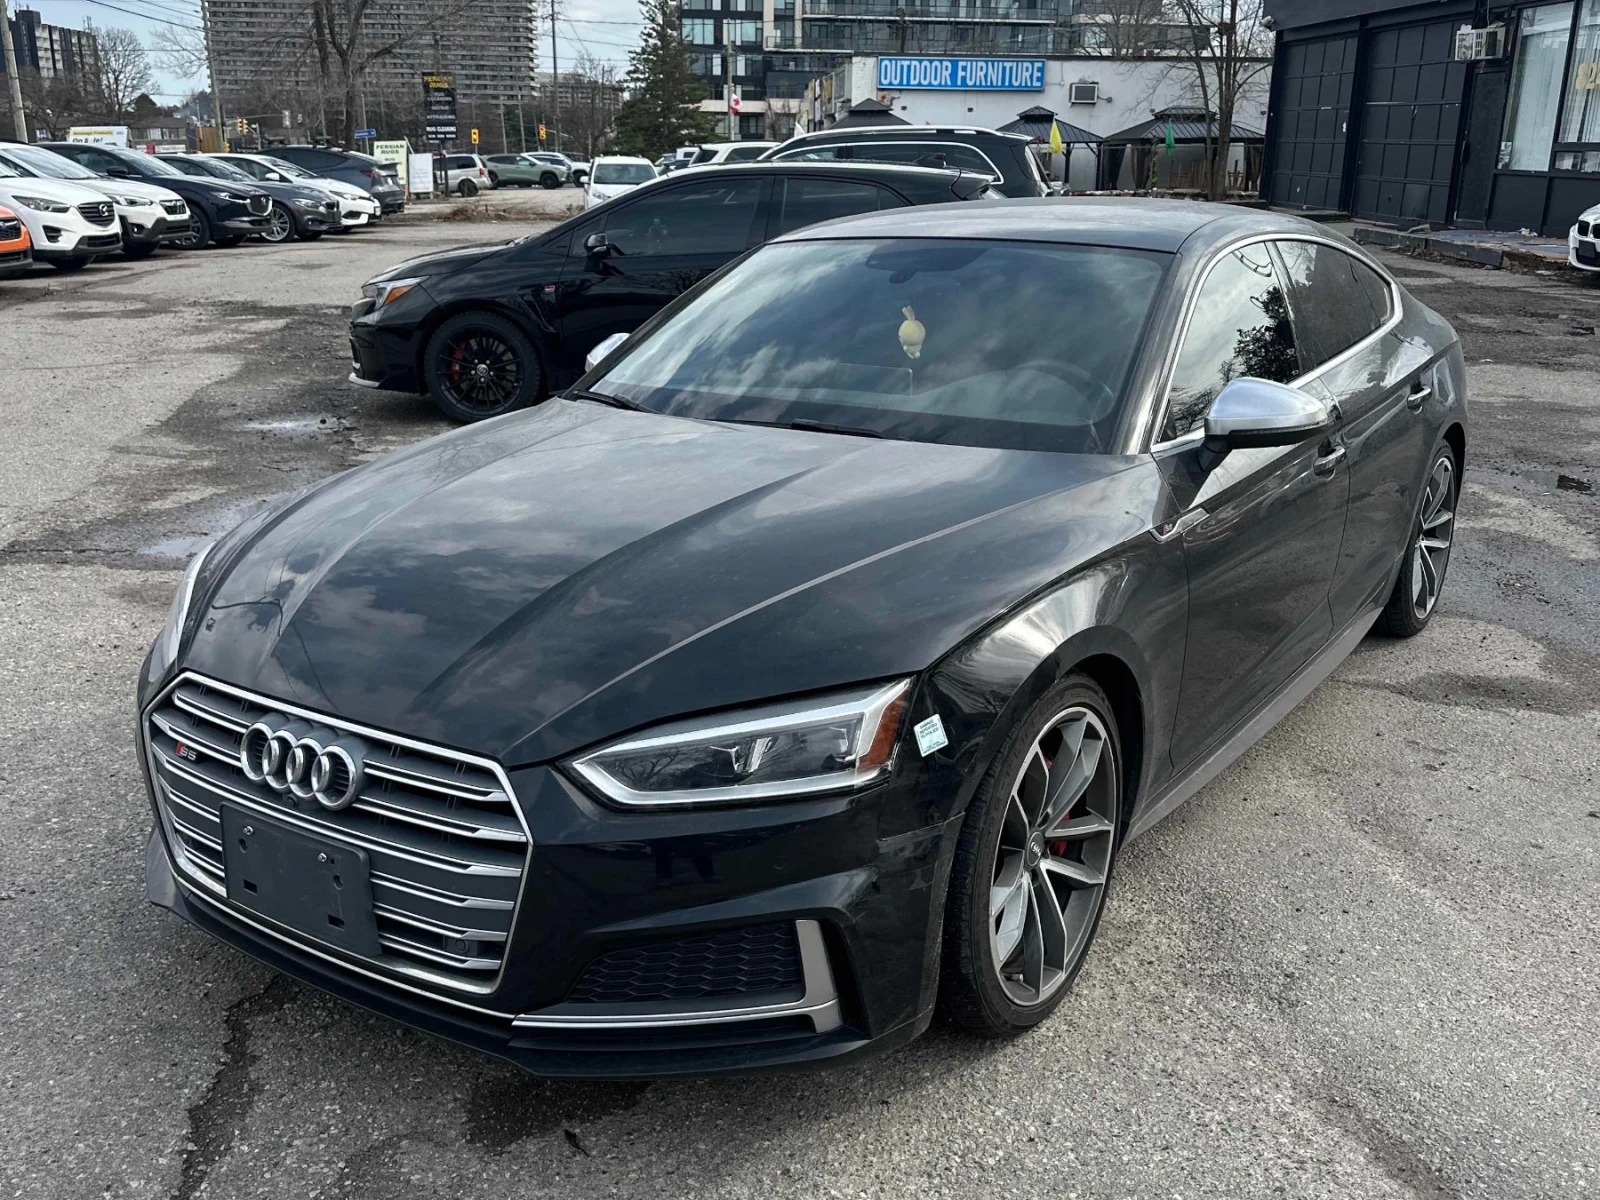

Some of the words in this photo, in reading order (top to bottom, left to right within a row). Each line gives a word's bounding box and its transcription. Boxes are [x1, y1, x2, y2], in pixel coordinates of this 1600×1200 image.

[880, 60, 952, 86] OUTDOOR
[957, 61, 1043, 87] FURNITURE
[180, 746, 197, 761] S5
